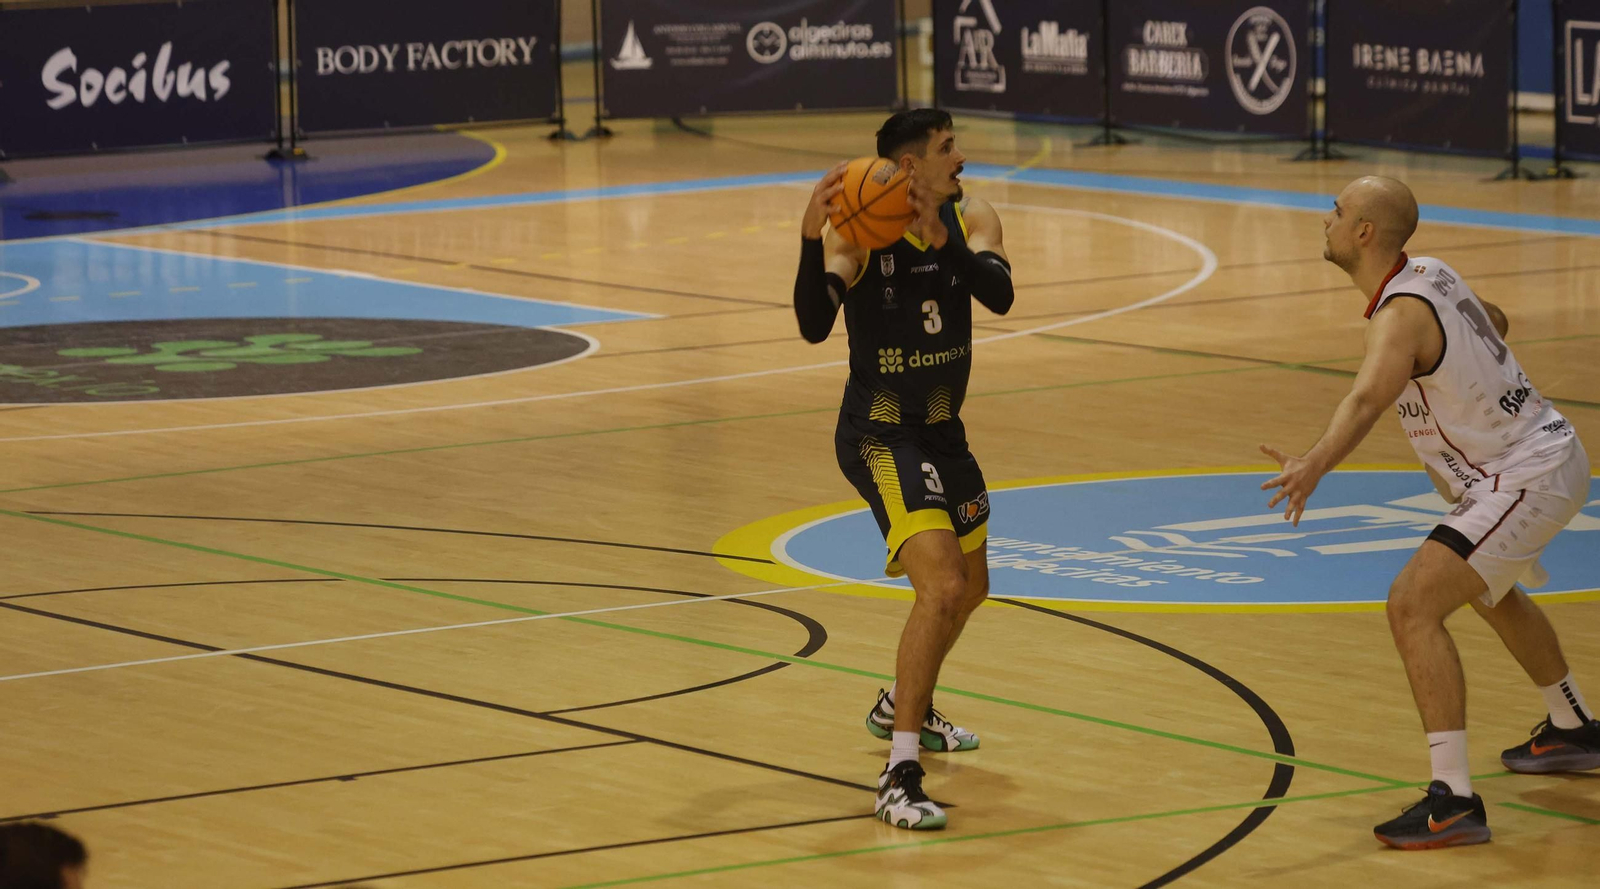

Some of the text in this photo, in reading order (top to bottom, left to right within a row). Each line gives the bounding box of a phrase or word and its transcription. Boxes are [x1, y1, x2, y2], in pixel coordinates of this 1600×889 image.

[316, 36, 538, 76] BODY FACTORY
[1352, 42, 1485, 78] IRENE BAENA
[41, 41, 231, 110] Socibus
[921, 300, 943, 335] 3
[908, 338, 972, 368] damex.i
[921, 462, 944, 494] 3
